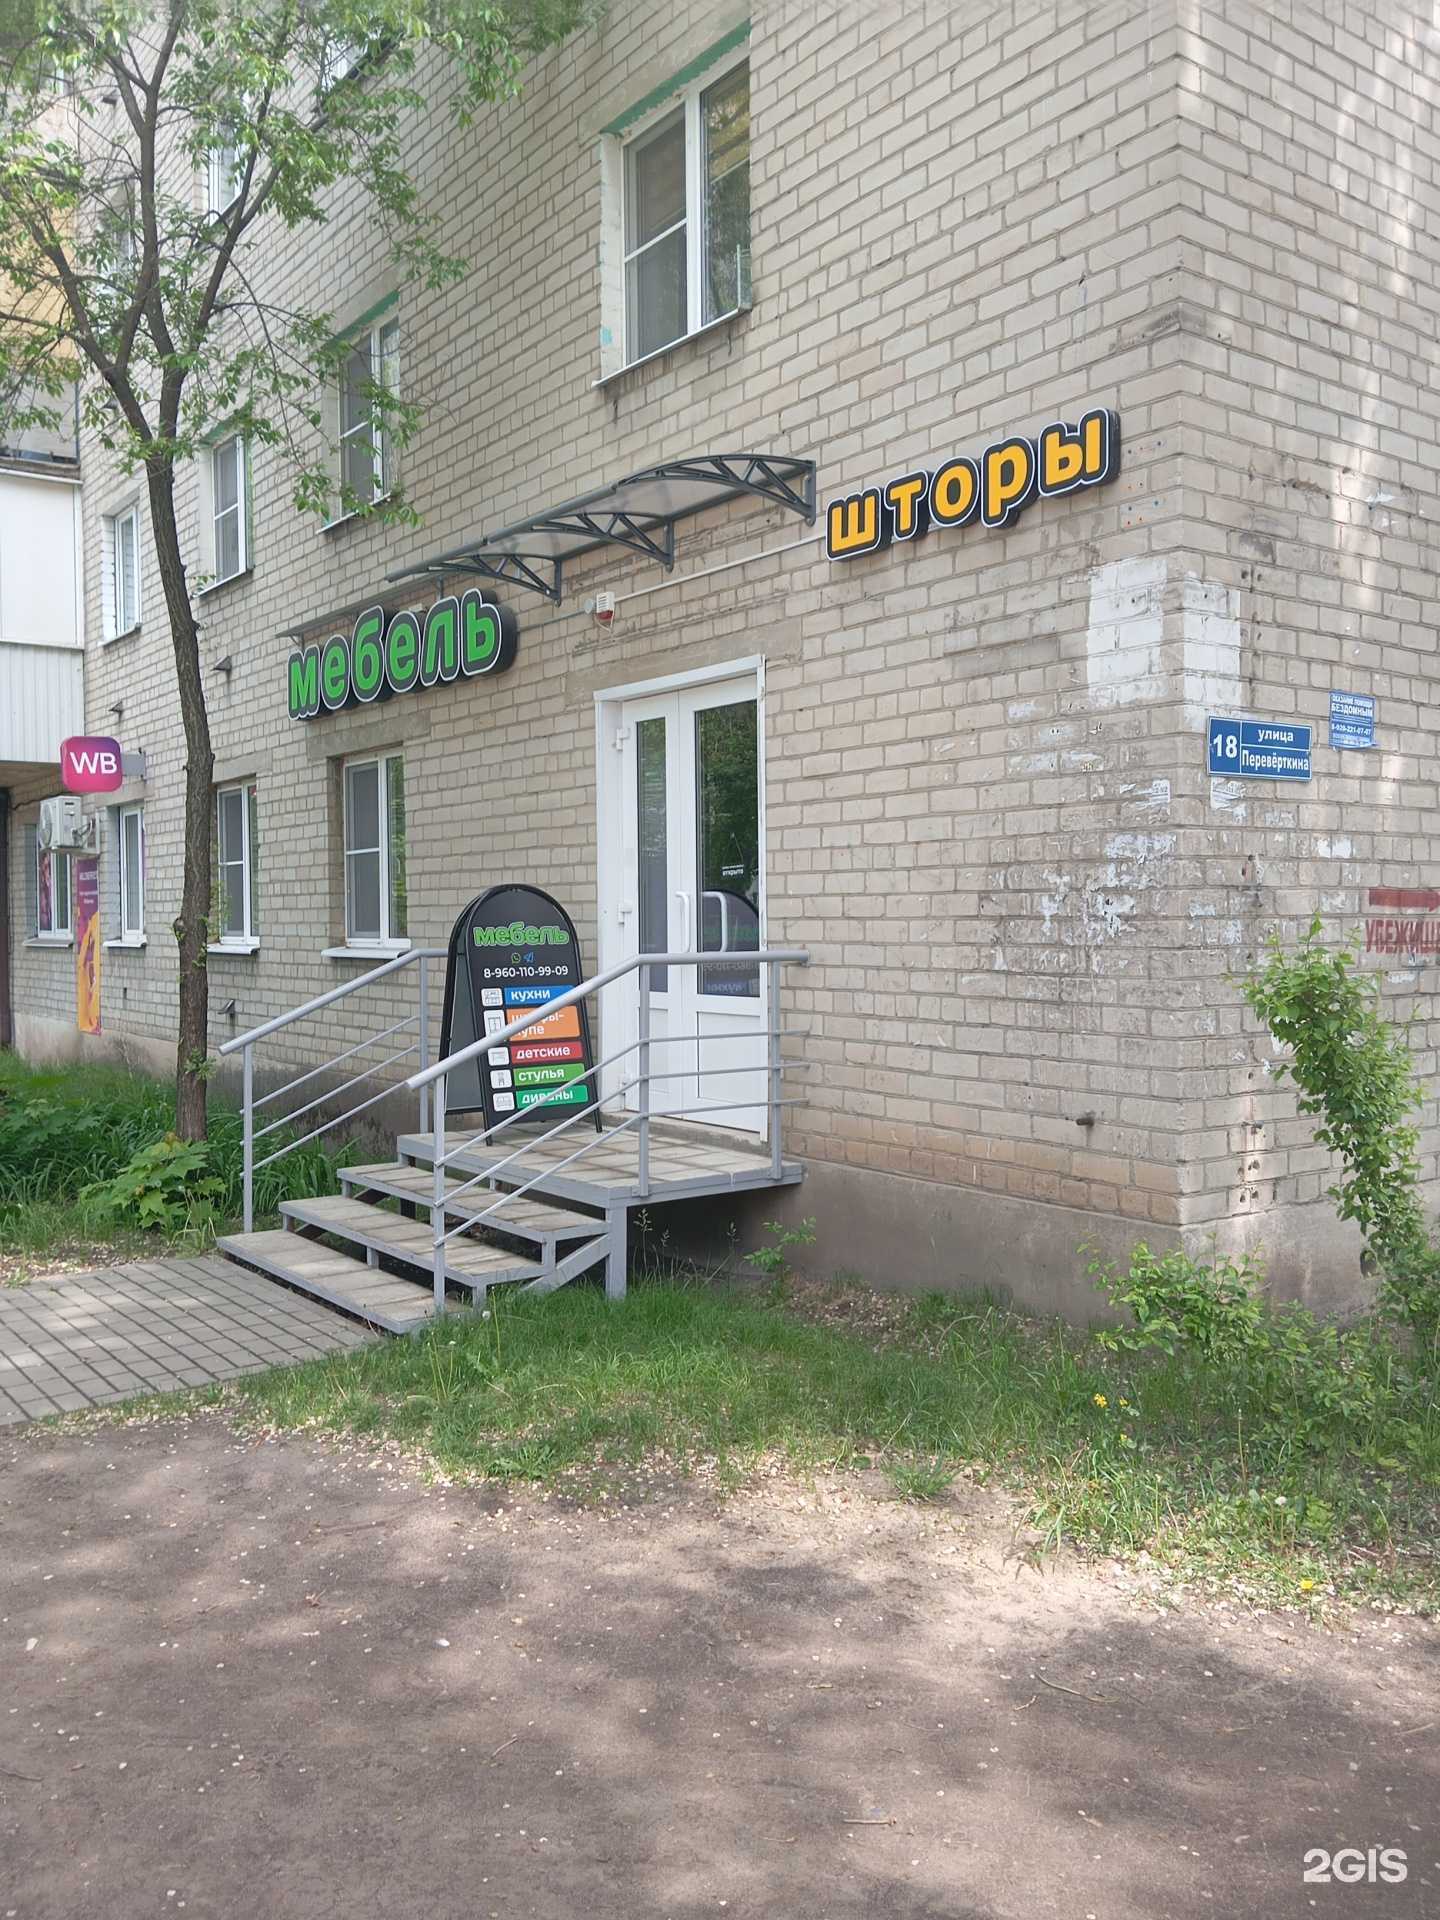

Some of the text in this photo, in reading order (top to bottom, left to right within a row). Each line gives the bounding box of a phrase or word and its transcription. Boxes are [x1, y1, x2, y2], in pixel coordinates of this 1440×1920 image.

[829, 412, 1106, 557] шторы
[289, 592, 499, 716] мебель
[1257, 727, 1294, 743] улица
[1212, 734, 1238, 759] 18
[69, 751, 118, 775] WB
[1241, 750, 1309, 773] Перевёрткина
[473, 921, 570, 946] мебель
[483, 965, 569, 979] 8-960-110-99-09
[511, 989, 551, 1002] кухни
[516, 1025, 545, 1038] упе
[516, 1046, 571, 1060] детские
[518, 1068, 565, 1082] стулья
